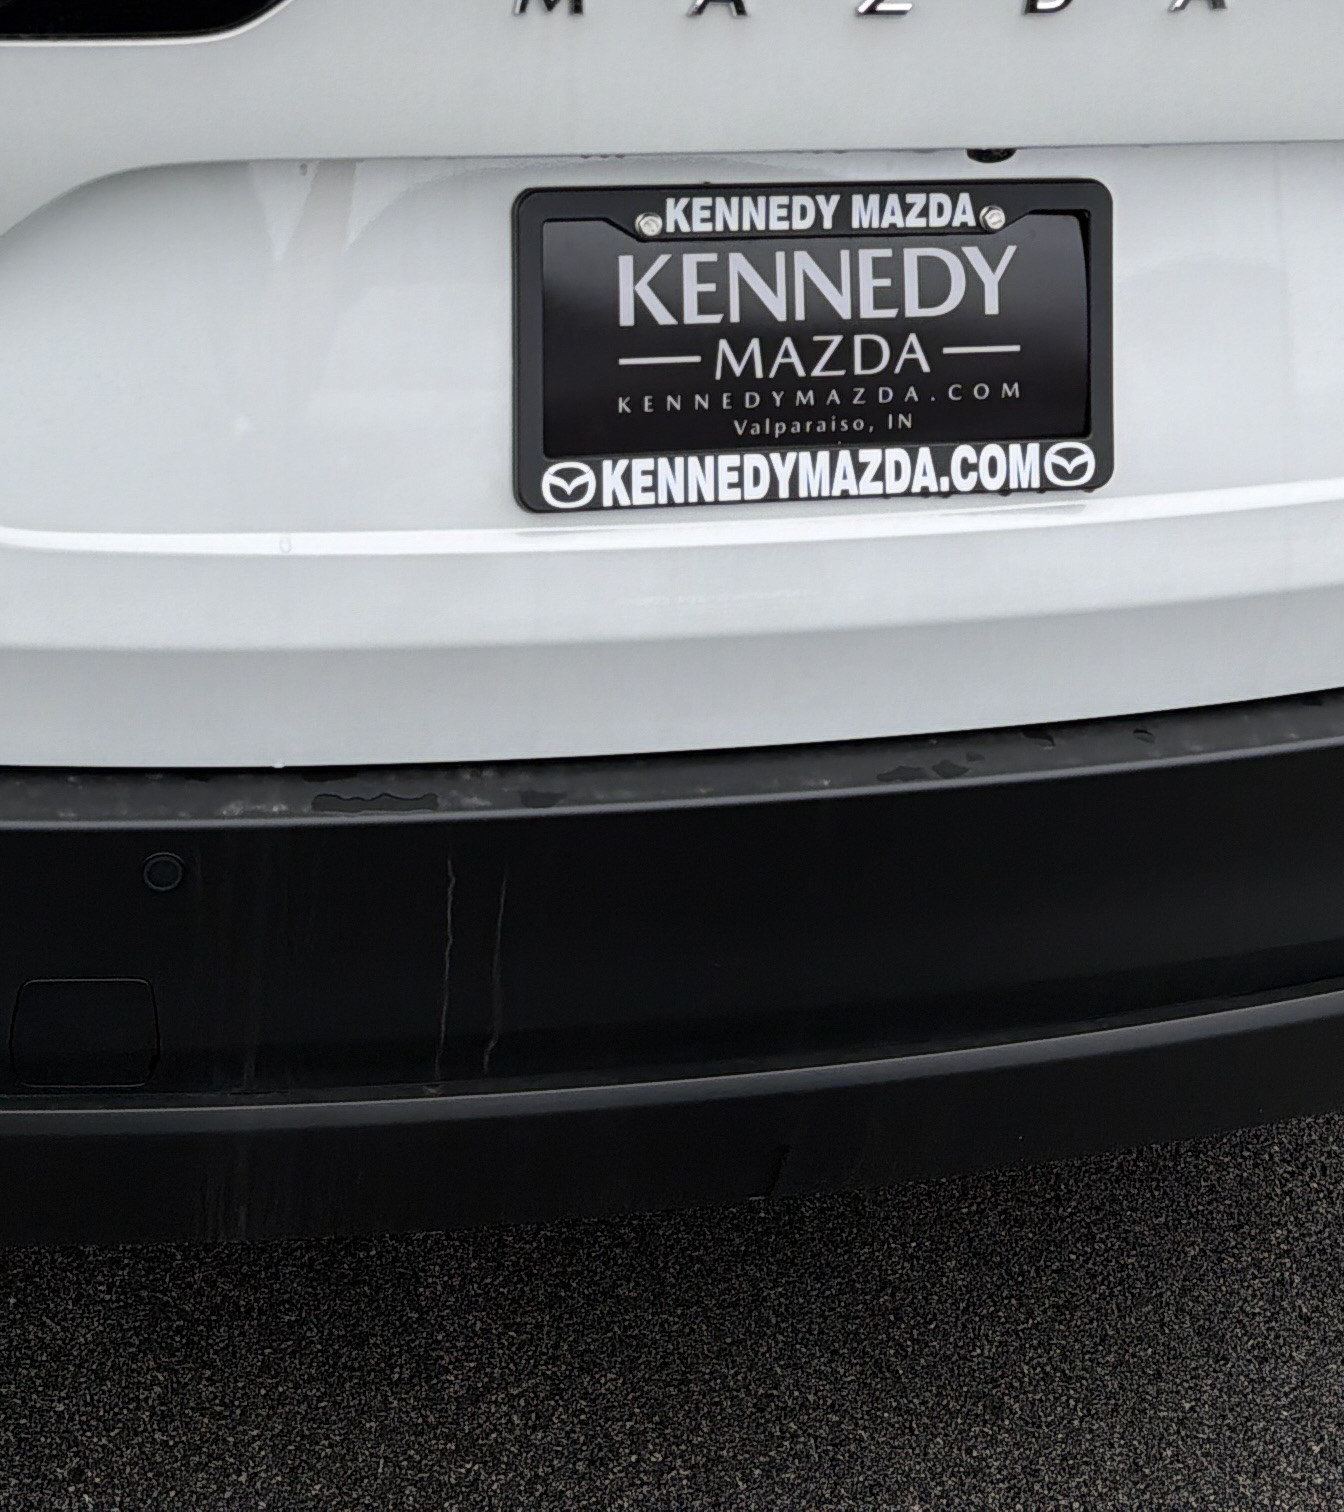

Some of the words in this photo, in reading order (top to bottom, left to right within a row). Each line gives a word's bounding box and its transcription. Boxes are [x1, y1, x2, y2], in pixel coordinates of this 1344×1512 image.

[665, 194, 841, 233] KENNEDY
[851, 192, 977, 230] MAZDA
[617, 244, 1018, 328] KENNEDY
[714, 333, 931, 381] MAZDA
[617, 381, 1022, 414] KENNEDYMAZDA.COM
[733, 414, 874, 439] Valparaiso,
[888, 413, 914, 431] IN
[601, 441, 1042, 508] KENNEDYMAZDA.COM
